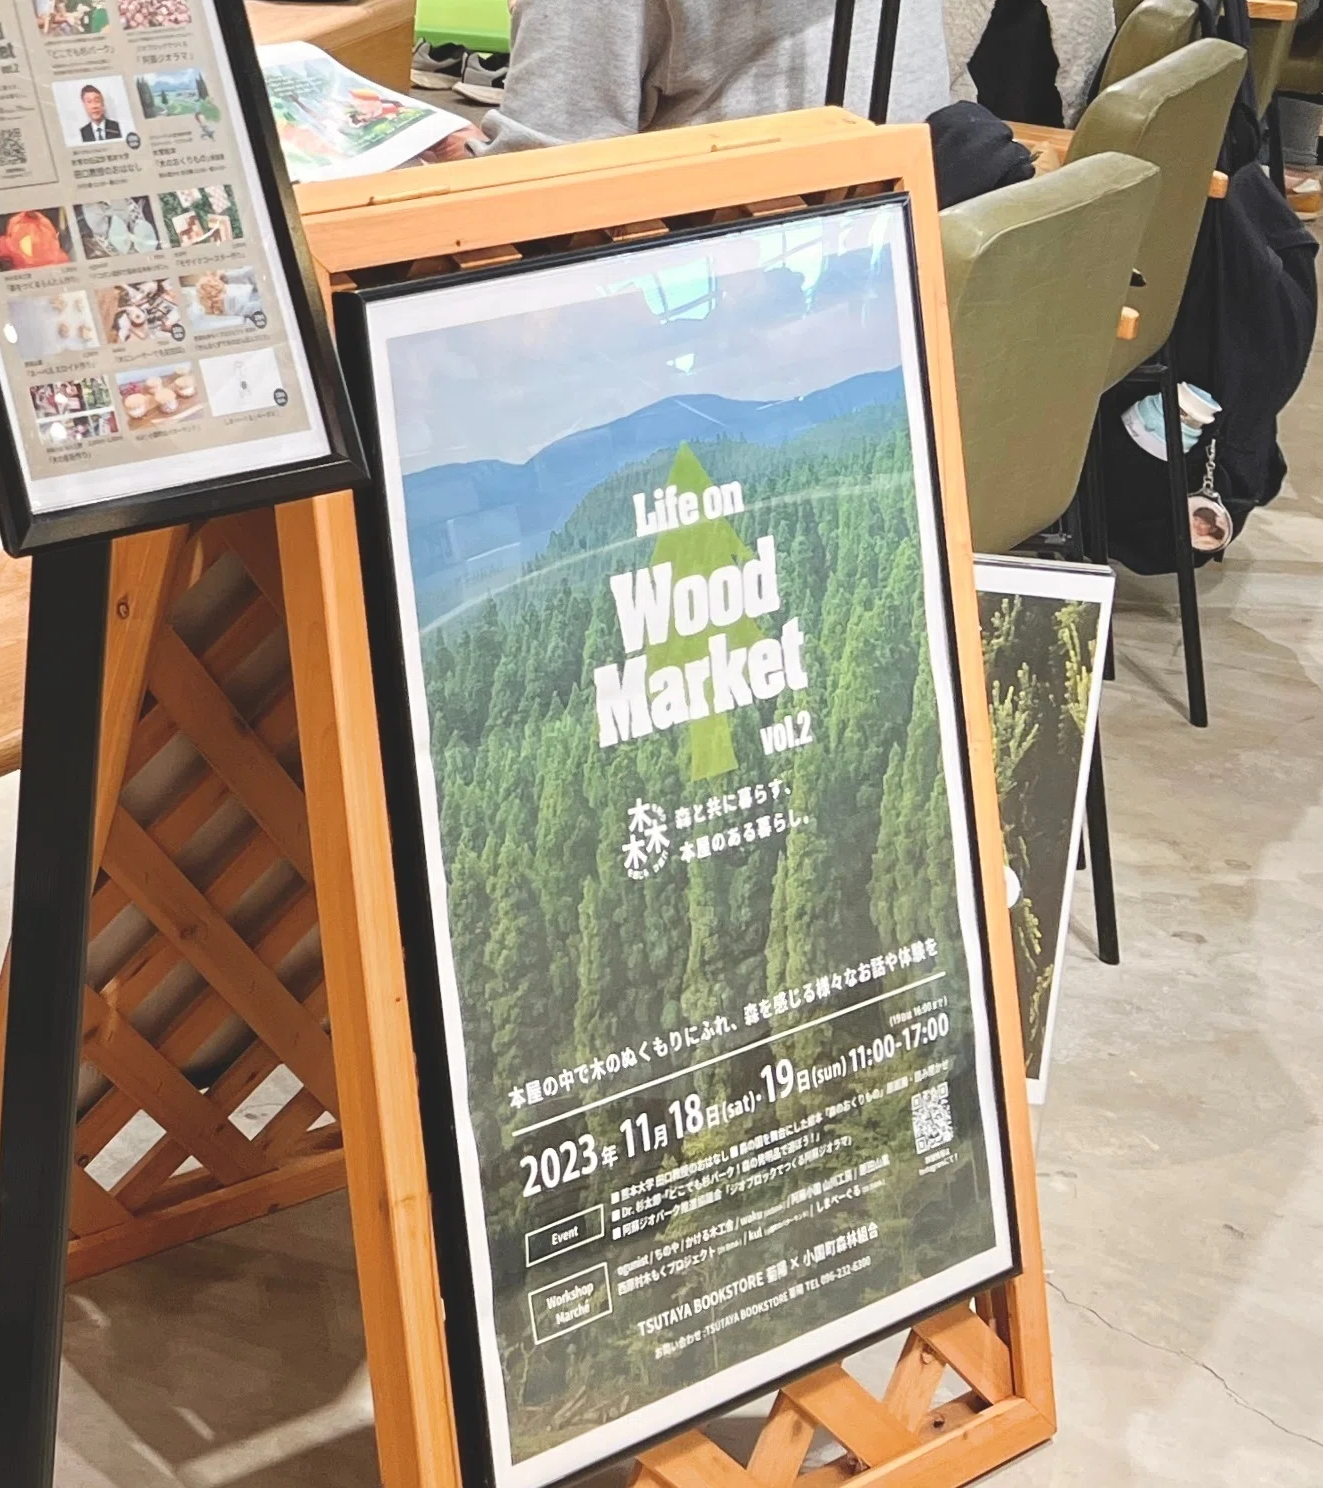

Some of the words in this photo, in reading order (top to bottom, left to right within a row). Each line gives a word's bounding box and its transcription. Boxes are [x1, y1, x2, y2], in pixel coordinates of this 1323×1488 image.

[633, 485, 700, 538] Life
[701, 478, 745, 522] on
[609, 534, 781, 653] Wood
[593, 616, 808, 748] Market
[759, 711, 813, 756] vol.2
[551, 1225, 579, 1246] Event
[546, 1282, 594, 1310] Workshop
[555, 1298, 591, 1325] Marché
[636, 1304, 693, 1337] TSUTAYA
[692, 1273, 765, 1314] BOOKSTORE
[740, 1291, 789, 1320] BOOKSTORE
[805, 1276, 821, 1292] TEL
